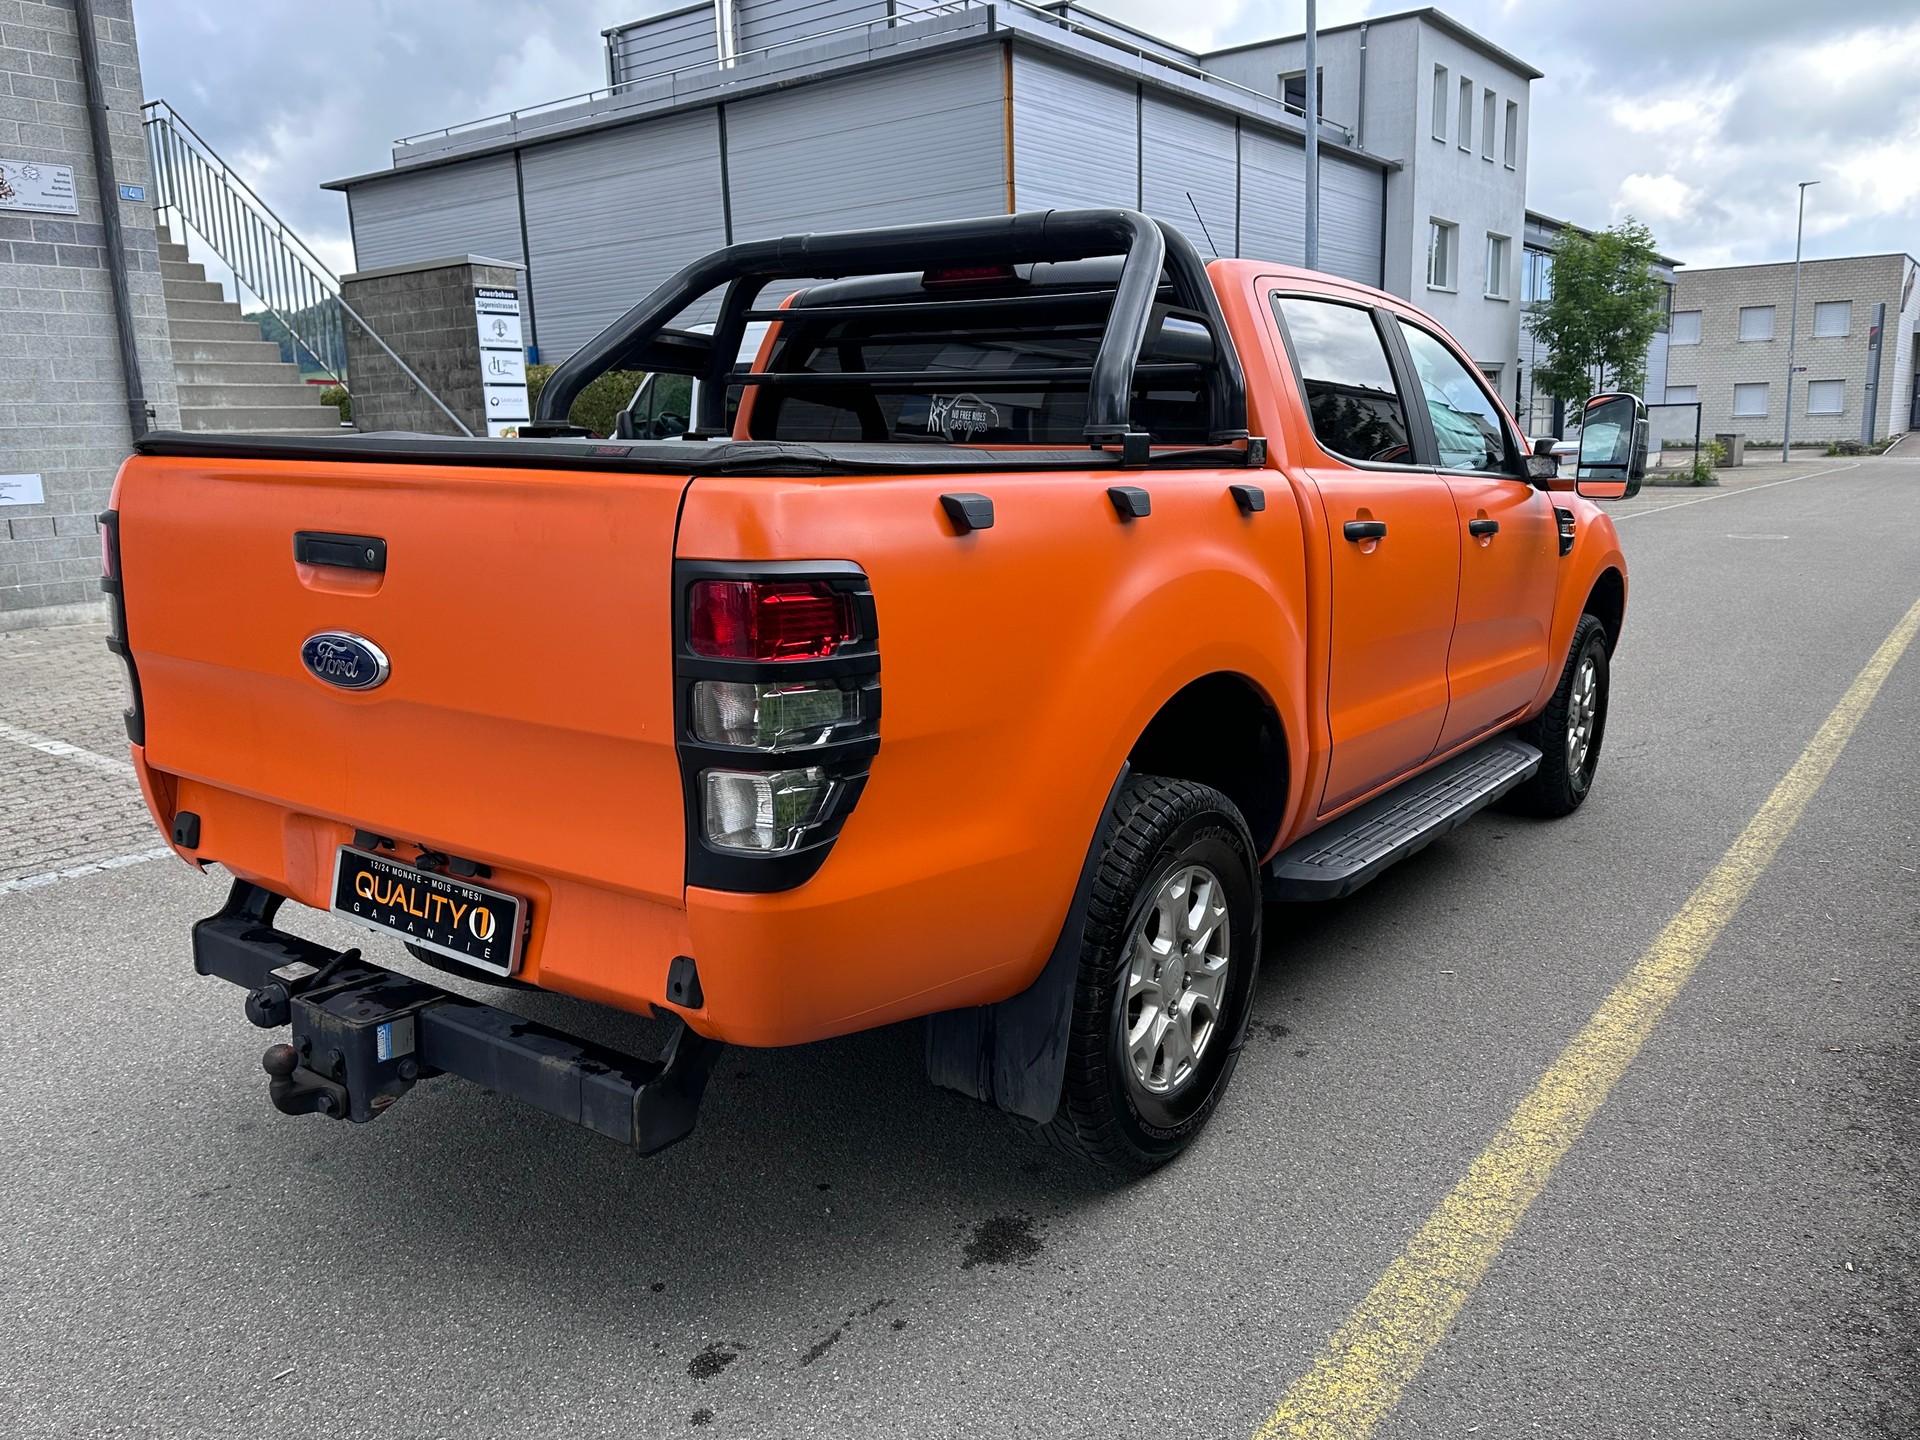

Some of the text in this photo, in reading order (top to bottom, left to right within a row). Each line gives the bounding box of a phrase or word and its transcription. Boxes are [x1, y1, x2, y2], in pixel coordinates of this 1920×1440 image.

[128, 187, 136, 198] 4
[478, 289, 515, 299] Gewerbehaus
[477, 301, 513, 309] Sägereistrasse
[951, 409, 987, 422] NO FREE RIDES
[950, 419, 963, 431] GAS
[963, 420, 974, 431] OR
[313, 641, 359, 678] Ford
[370, 860, 390, 873] 12/24
[392, 867, 422, 884] MONATE
[431, 879, 451, 893] MOIS
[462, 888, 483, 902] MESI
[355, 871, 468, 929] QUALITY
[353, 902, 491, 959] GARANTIE
